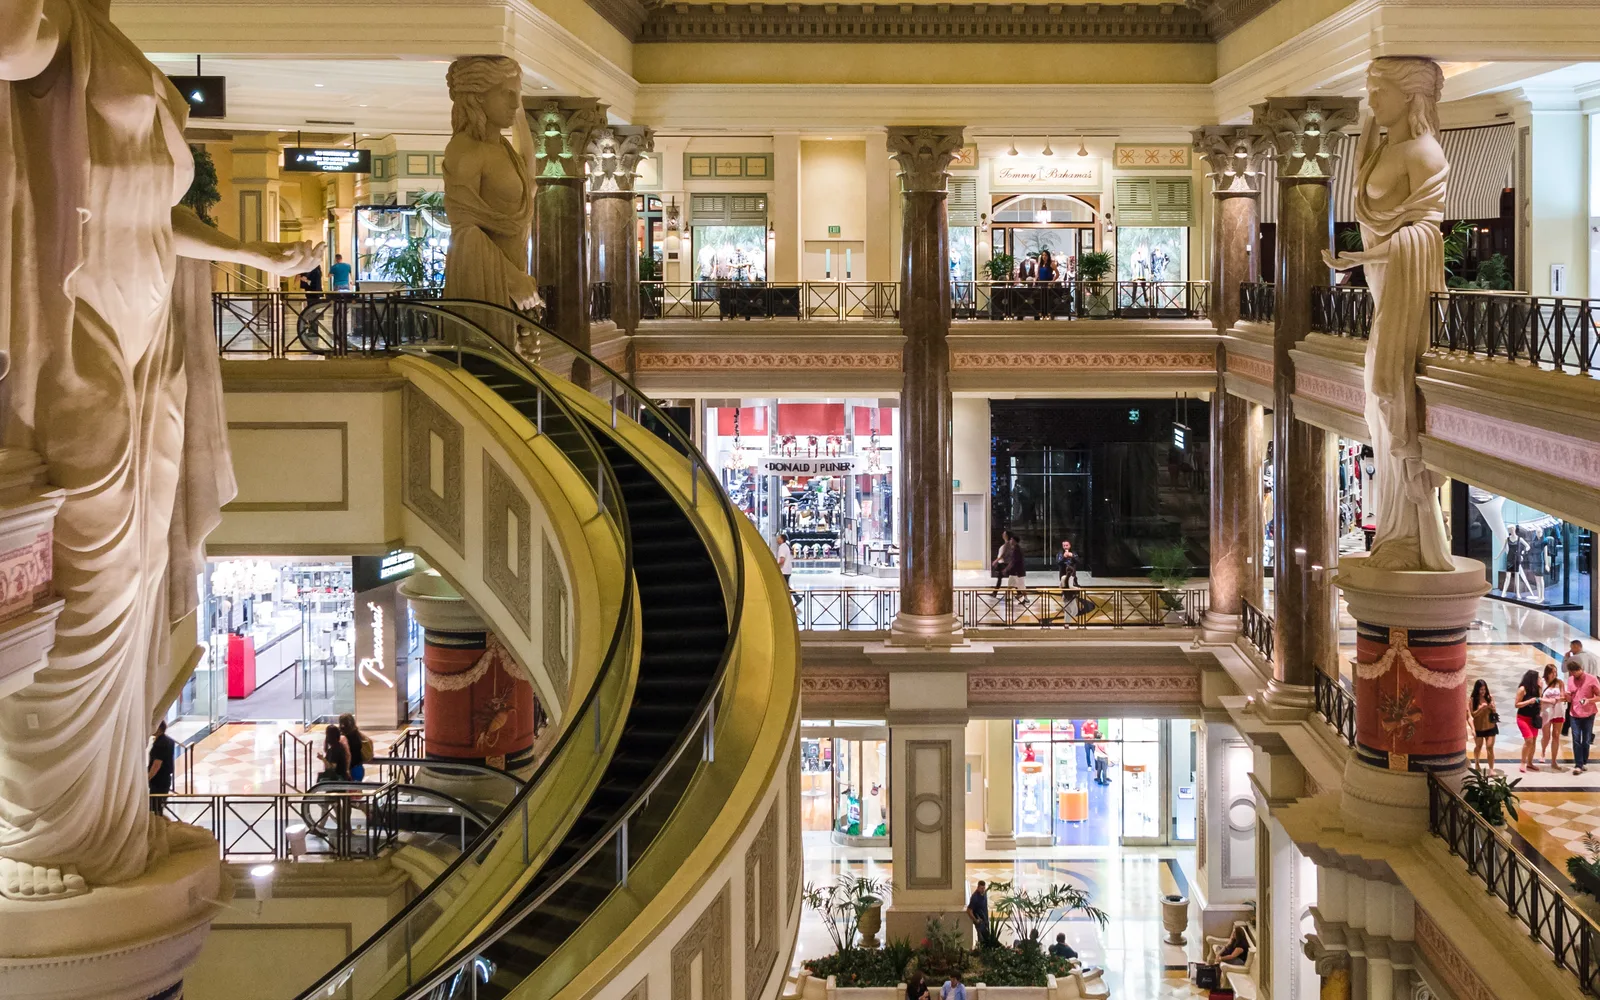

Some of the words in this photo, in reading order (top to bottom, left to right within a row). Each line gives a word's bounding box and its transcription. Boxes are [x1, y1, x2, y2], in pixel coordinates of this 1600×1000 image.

[999, 168, 1037, 182] Tommy
[1045, 168, 1092, 179] Bahama's
[769, 462, 810, 473] DONALD
[813, 464, 818, 474] J
[820, 462, 851, 473] PLINER
